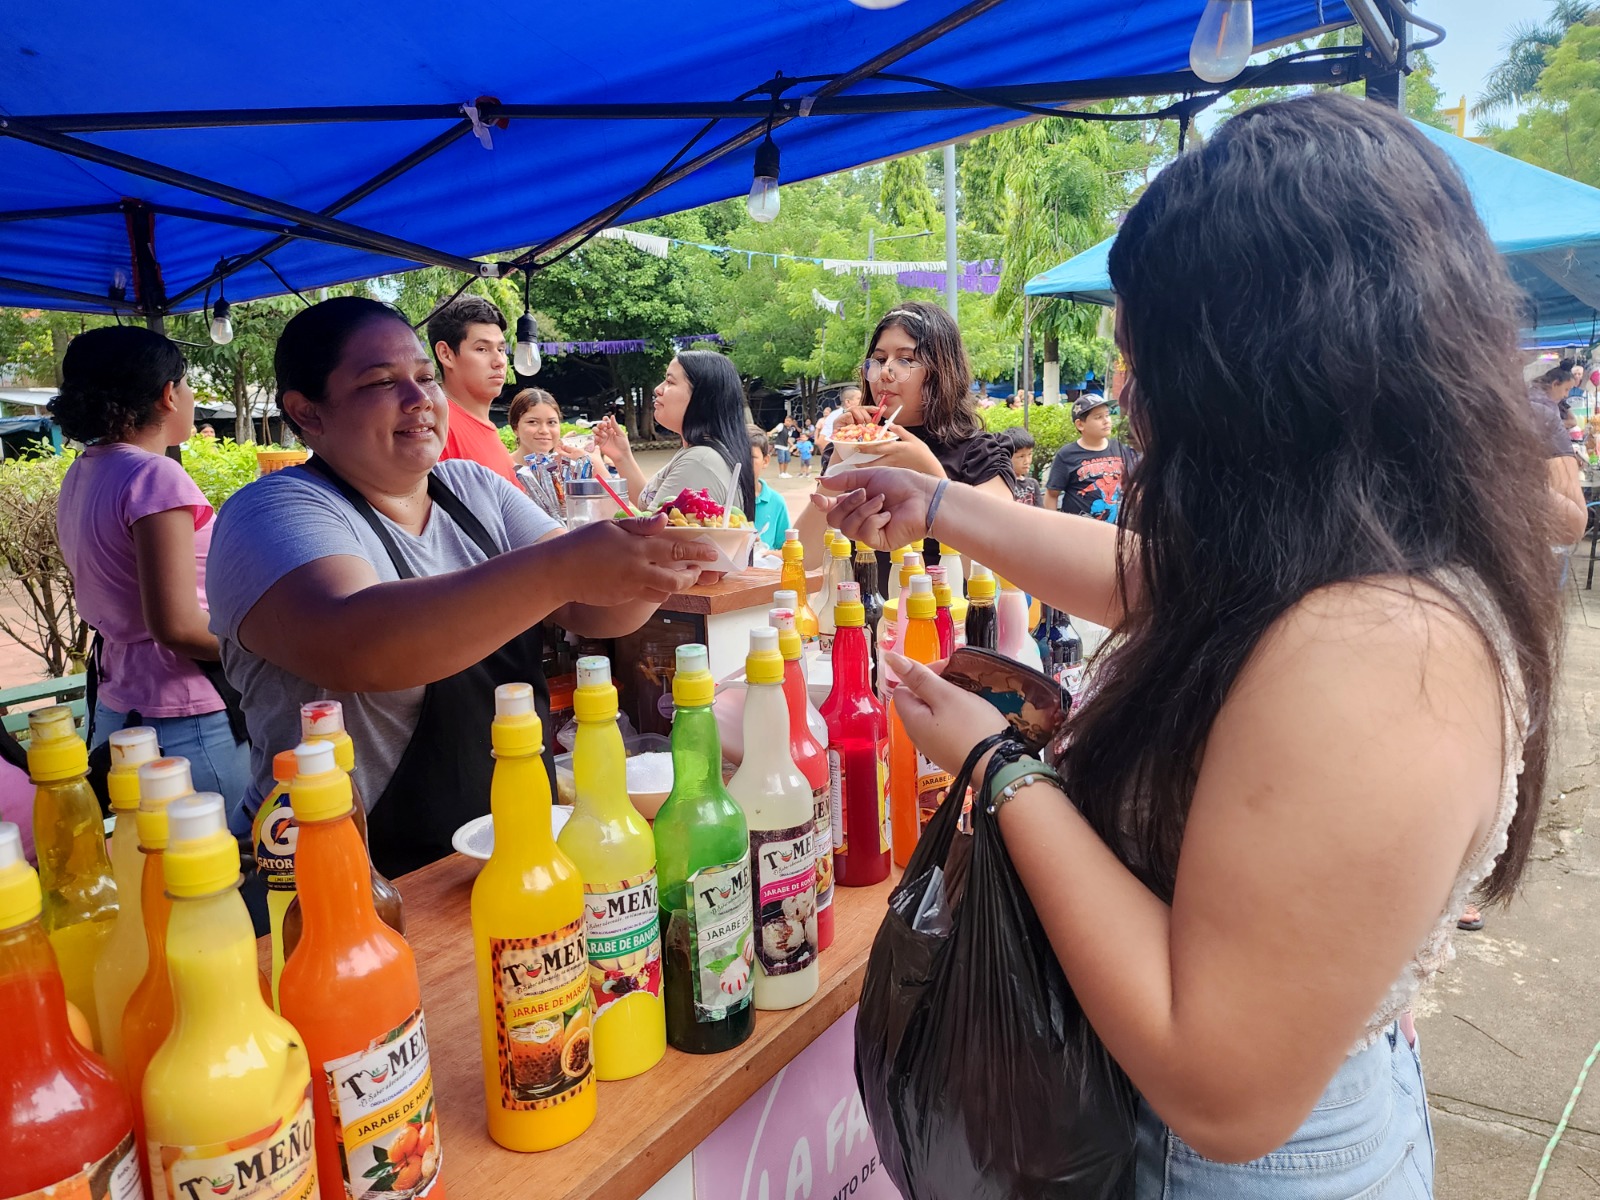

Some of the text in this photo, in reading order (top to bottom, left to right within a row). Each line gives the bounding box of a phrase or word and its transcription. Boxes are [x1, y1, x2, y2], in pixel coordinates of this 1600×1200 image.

[921, 775, 946, 786] JARABE
[257, 857, 294, 869] GATOR
[763, 884, 790, 897] JARABE
[791, 881, 799, 890] DE
[587, 941, 617, 954] ARABE
[619, 939, 631, 951] DE
[633, 924, 659, 945] BANAN
[706, 919, 741, 941] JARABE
[512, 984, 588, 1018] JARABE DE MARAC
[357, 1112, 401, 1137] JARABE
[403, 1100, 415, 1115] DE
[861, 1156, 876, 1183] DE
